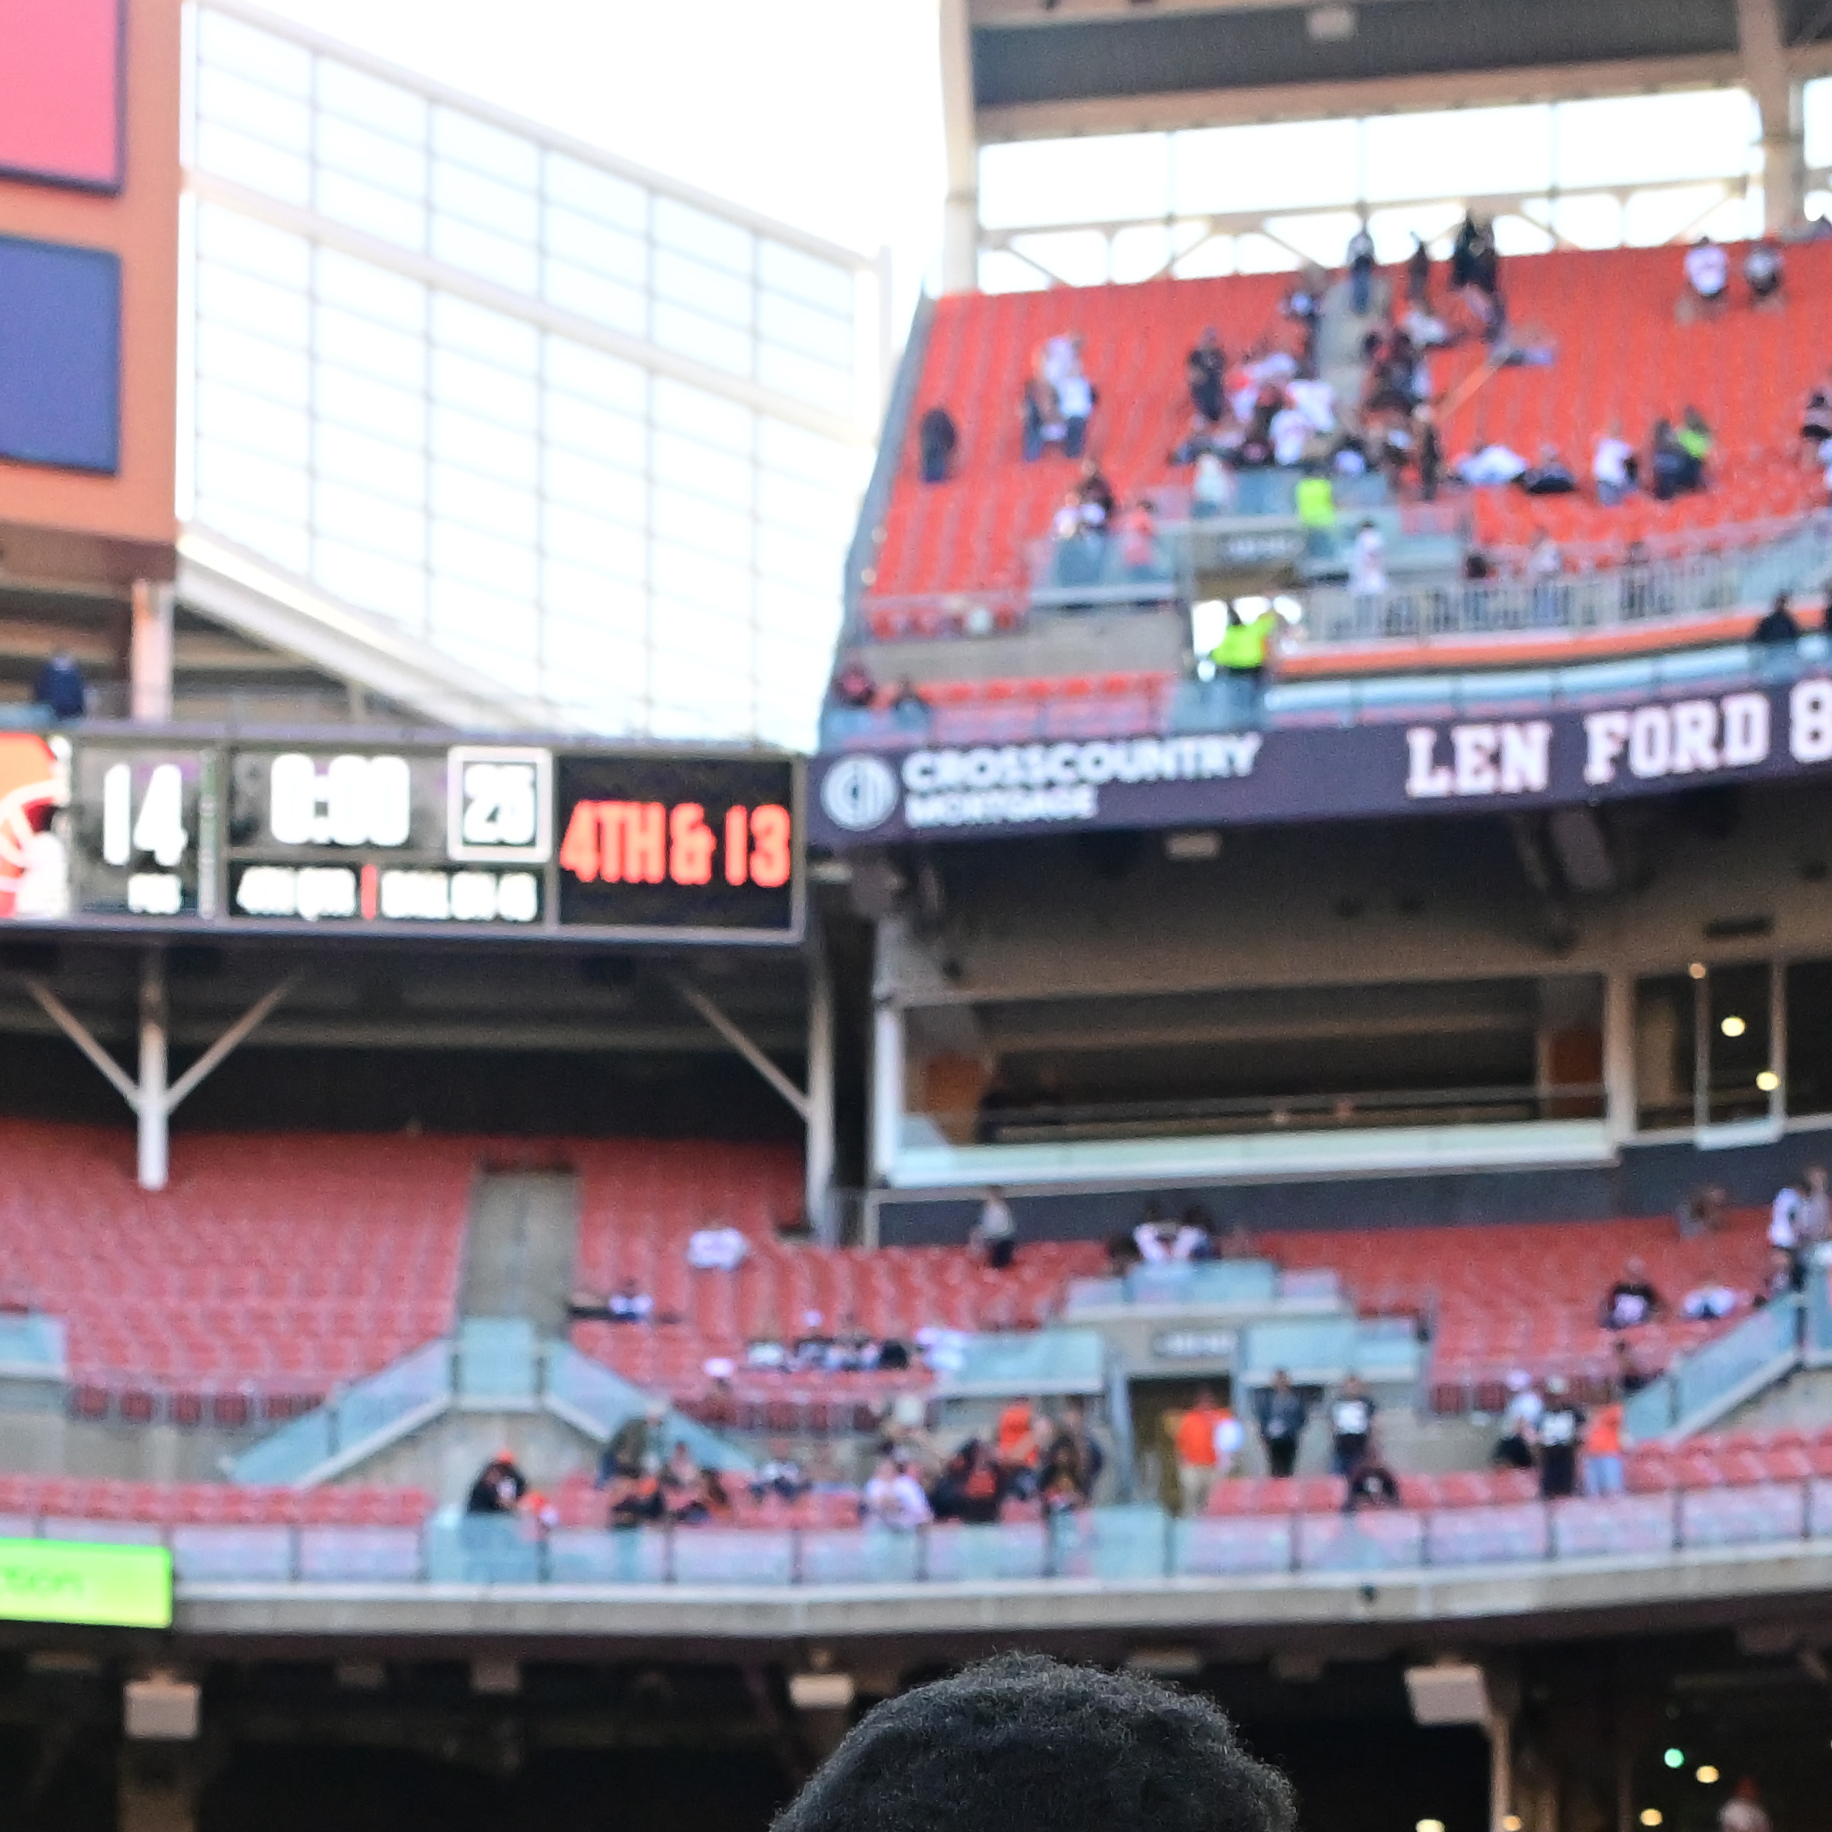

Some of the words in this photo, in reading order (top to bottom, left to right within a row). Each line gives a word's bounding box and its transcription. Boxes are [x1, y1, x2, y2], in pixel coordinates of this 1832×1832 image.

[902, 732, 1264, 791] CROSSCOUNTRY
[1404, 720, 1553, 799] LEN
[1582, 691, 1772, 786] FORD
[104, 762, 188, 866] 14
[559, 799, 668, 885] 4TH
[669, 801, 716, 885] &
[724, 802, 792, 888] 13
